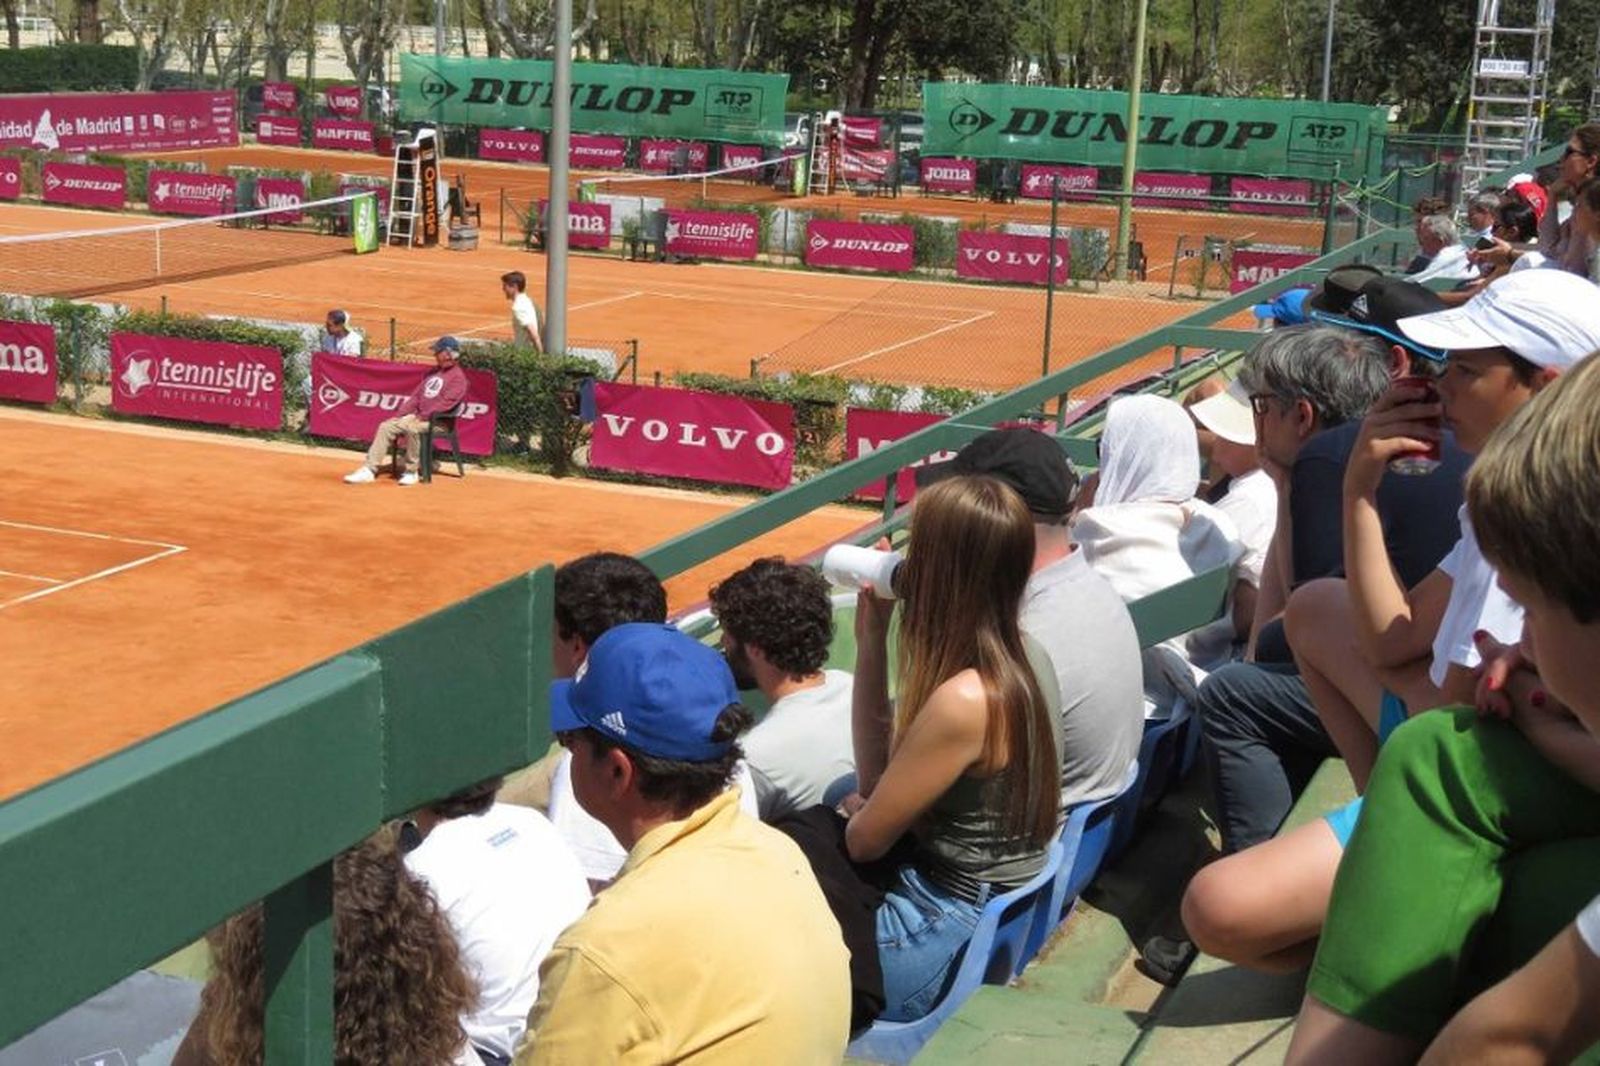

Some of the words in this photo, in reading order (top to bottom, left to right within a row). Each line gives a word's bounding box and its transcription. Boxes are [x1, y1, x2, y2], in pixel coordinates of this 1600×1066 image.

[0, 120, 32, 139] idad
[57, 119, 74, 136] de
[76, 115, 122, 135] Madrid
[316, 128, 371, 142] MAPFRE
[1000, 107, 1278, 150] DUNLOP
[483, 140, 540, 153] VOLVO
[63, 177, 122, 191] DUNLOP
[175, 182, 233, 201] tennislife
[567, 213, 606, 232] ma
[686, 221, 755, 242] tennislife
[832, 238, 909, 253] DUNLOP
[963, 247, 1063, 268] VOLVO
[159, 356, 277, 397] tennislife
[354, 390, 489, 420] DUP
[601, 413, 787, 456] VOLVO
